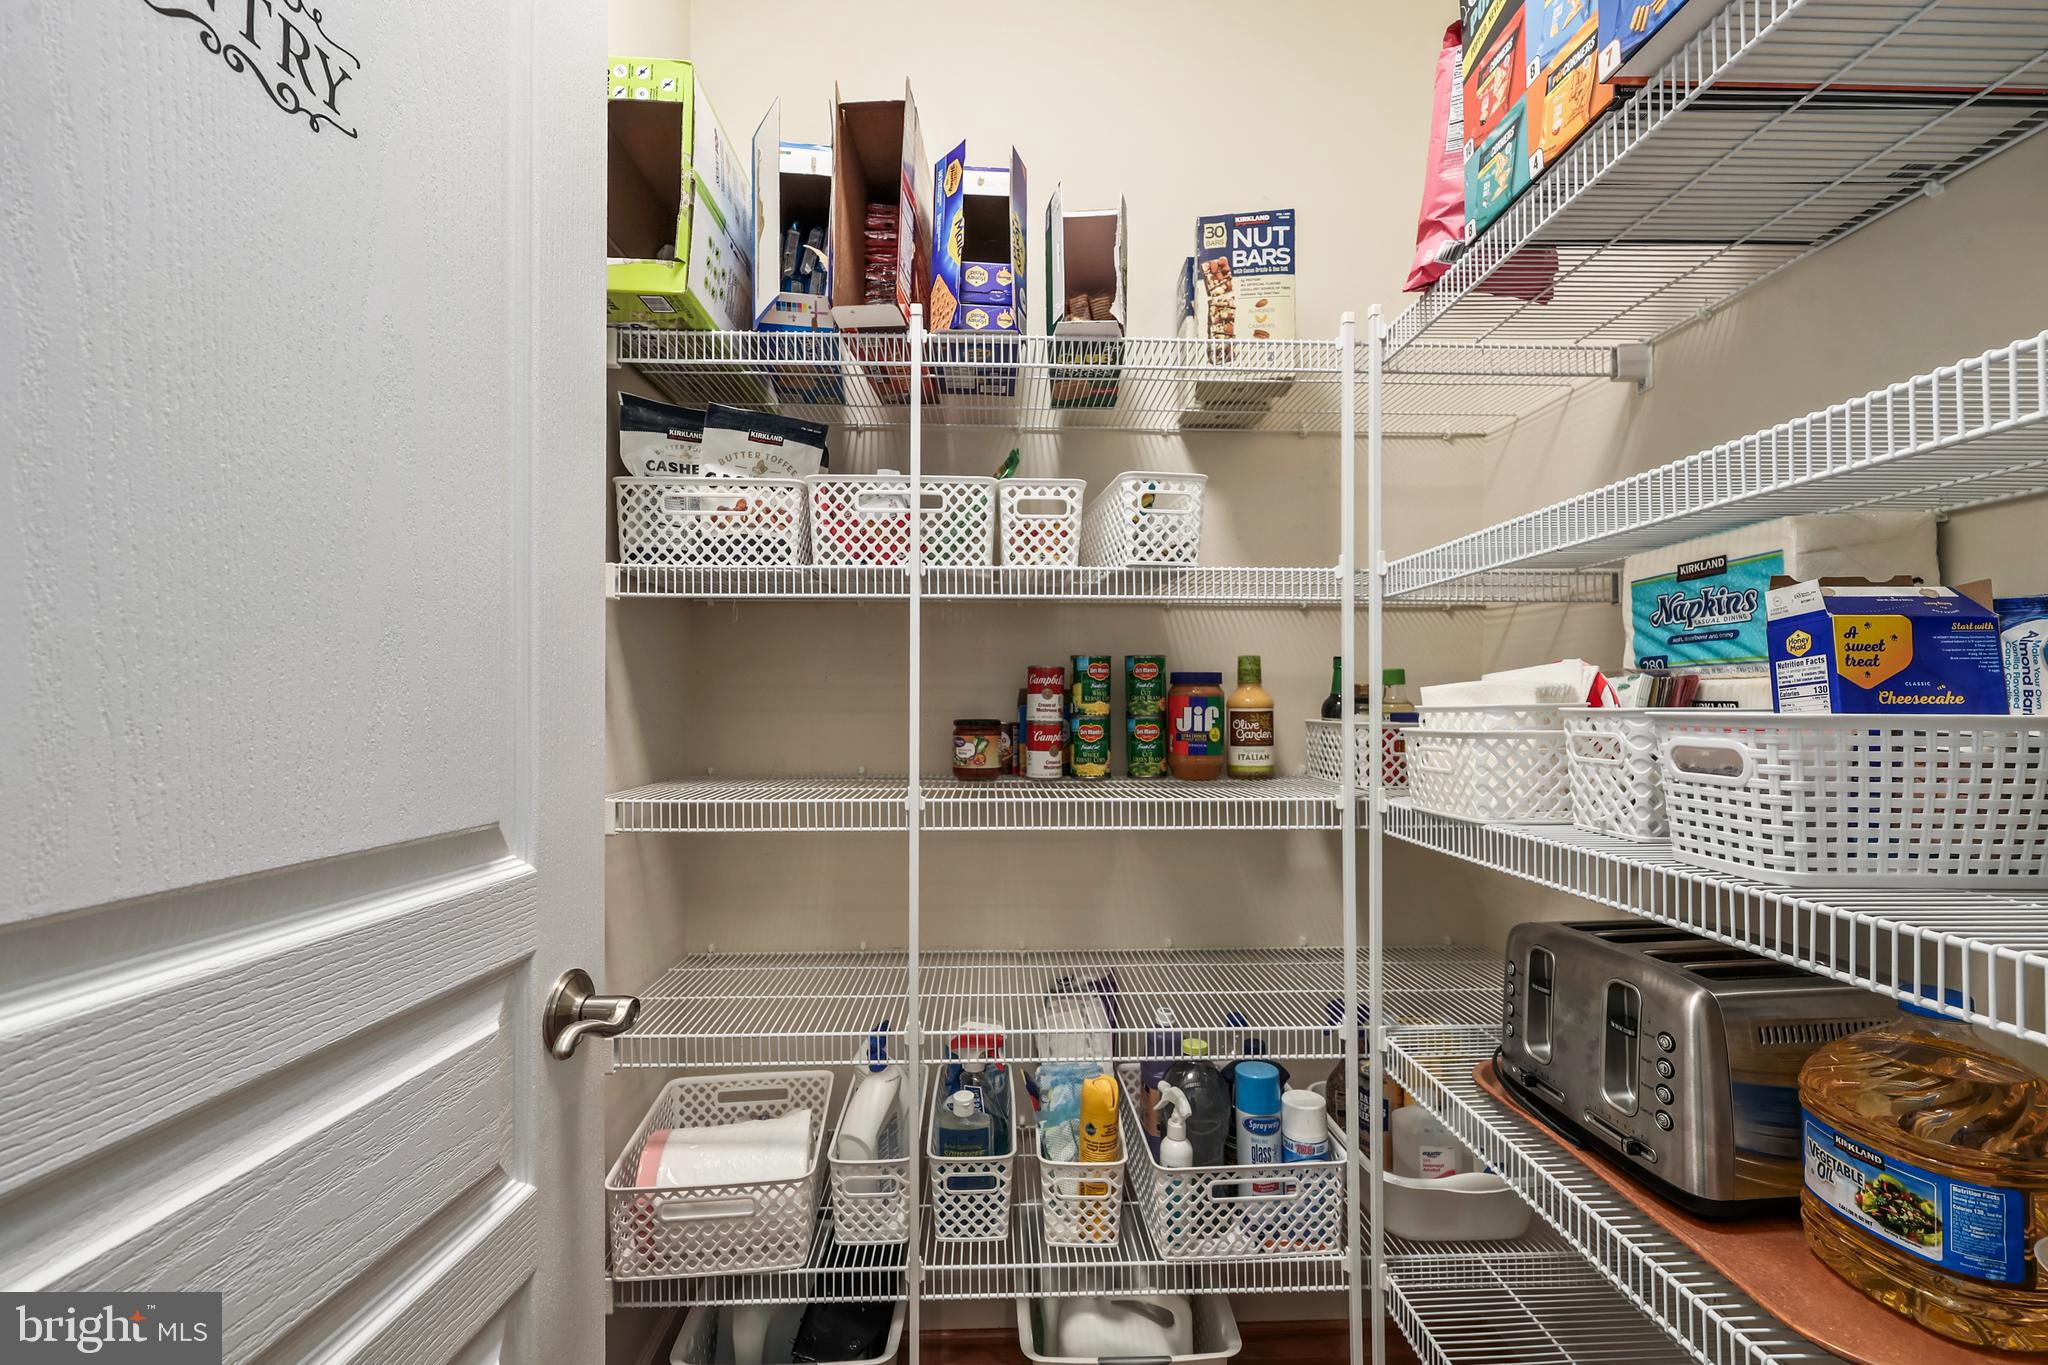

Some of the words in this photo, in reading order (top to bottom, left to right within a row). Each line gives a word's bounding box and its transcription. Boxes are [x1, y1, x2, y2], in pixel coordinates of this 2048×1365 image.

[1605, 47, 1613, 67] 7
[1234, 215, 1270, 223] KIRKLAND
[1205, 225, 1225, 239] 30
[1232, 226, 1290, 249] NUT
[1206, 239, 1225, 247] BARS
[1232, 248, 1291, 268] BARS
[751, 431, 783, 443] KIRKLAND
[718, 450, 761, 467] BUTTER
[765, 452, 798, 476] TOFFEE
[1680, 557, 1725, 576] KIRKLAND
[1652, 586, 1757, 631] Napkins
[1723, 613, 1748, 622] DINING
[1843, 626, 1860, 639] A
[1951, 622, 1973, 630] Start
[1974, 622, 1994, 630] with
[1789, 637, 1810, 646] Honey
[1790, 643, 1806, 652] Maid
[1844, 639, 1886, 652] sweet
[2004, 642, 2012, 671] Candy
[2011, 640, 2020, 670] Vanilla
[2019, 630, 2039, 686] Almond
[2032, 640, 2042, 665] Make
[1777, 661, 1804, 669] Nutrition
[1805, 657, 1825, 665] Facts
[1845, 654, 1881, 668] treat
[1813, 685, 1828, 694] 130
[2013, 672, 2021, 709] Flavored
[1878, 690, 1966, 705] Cheesecake
[2035, 689, 2043, 710] Own
[1176, 705, 1219, 732] Jif
[1232, 719, 1260, 730] Olive
[1235, 729, 1273, 742] Garden
[1237, 753, 1270, 761] ITALIAN
[1251, 1144, 1272, 1165] glass
[1834, 1135, 1882, 1164] KIRKLAND
[1808, 1137, 1865, 1188] VEGETABLE
[1817, 1161, 1836, 1185] OIL
[1952, 1186, 1982, 1198] Nutrition
[1982, 1192, 2001, 1201] Facts
